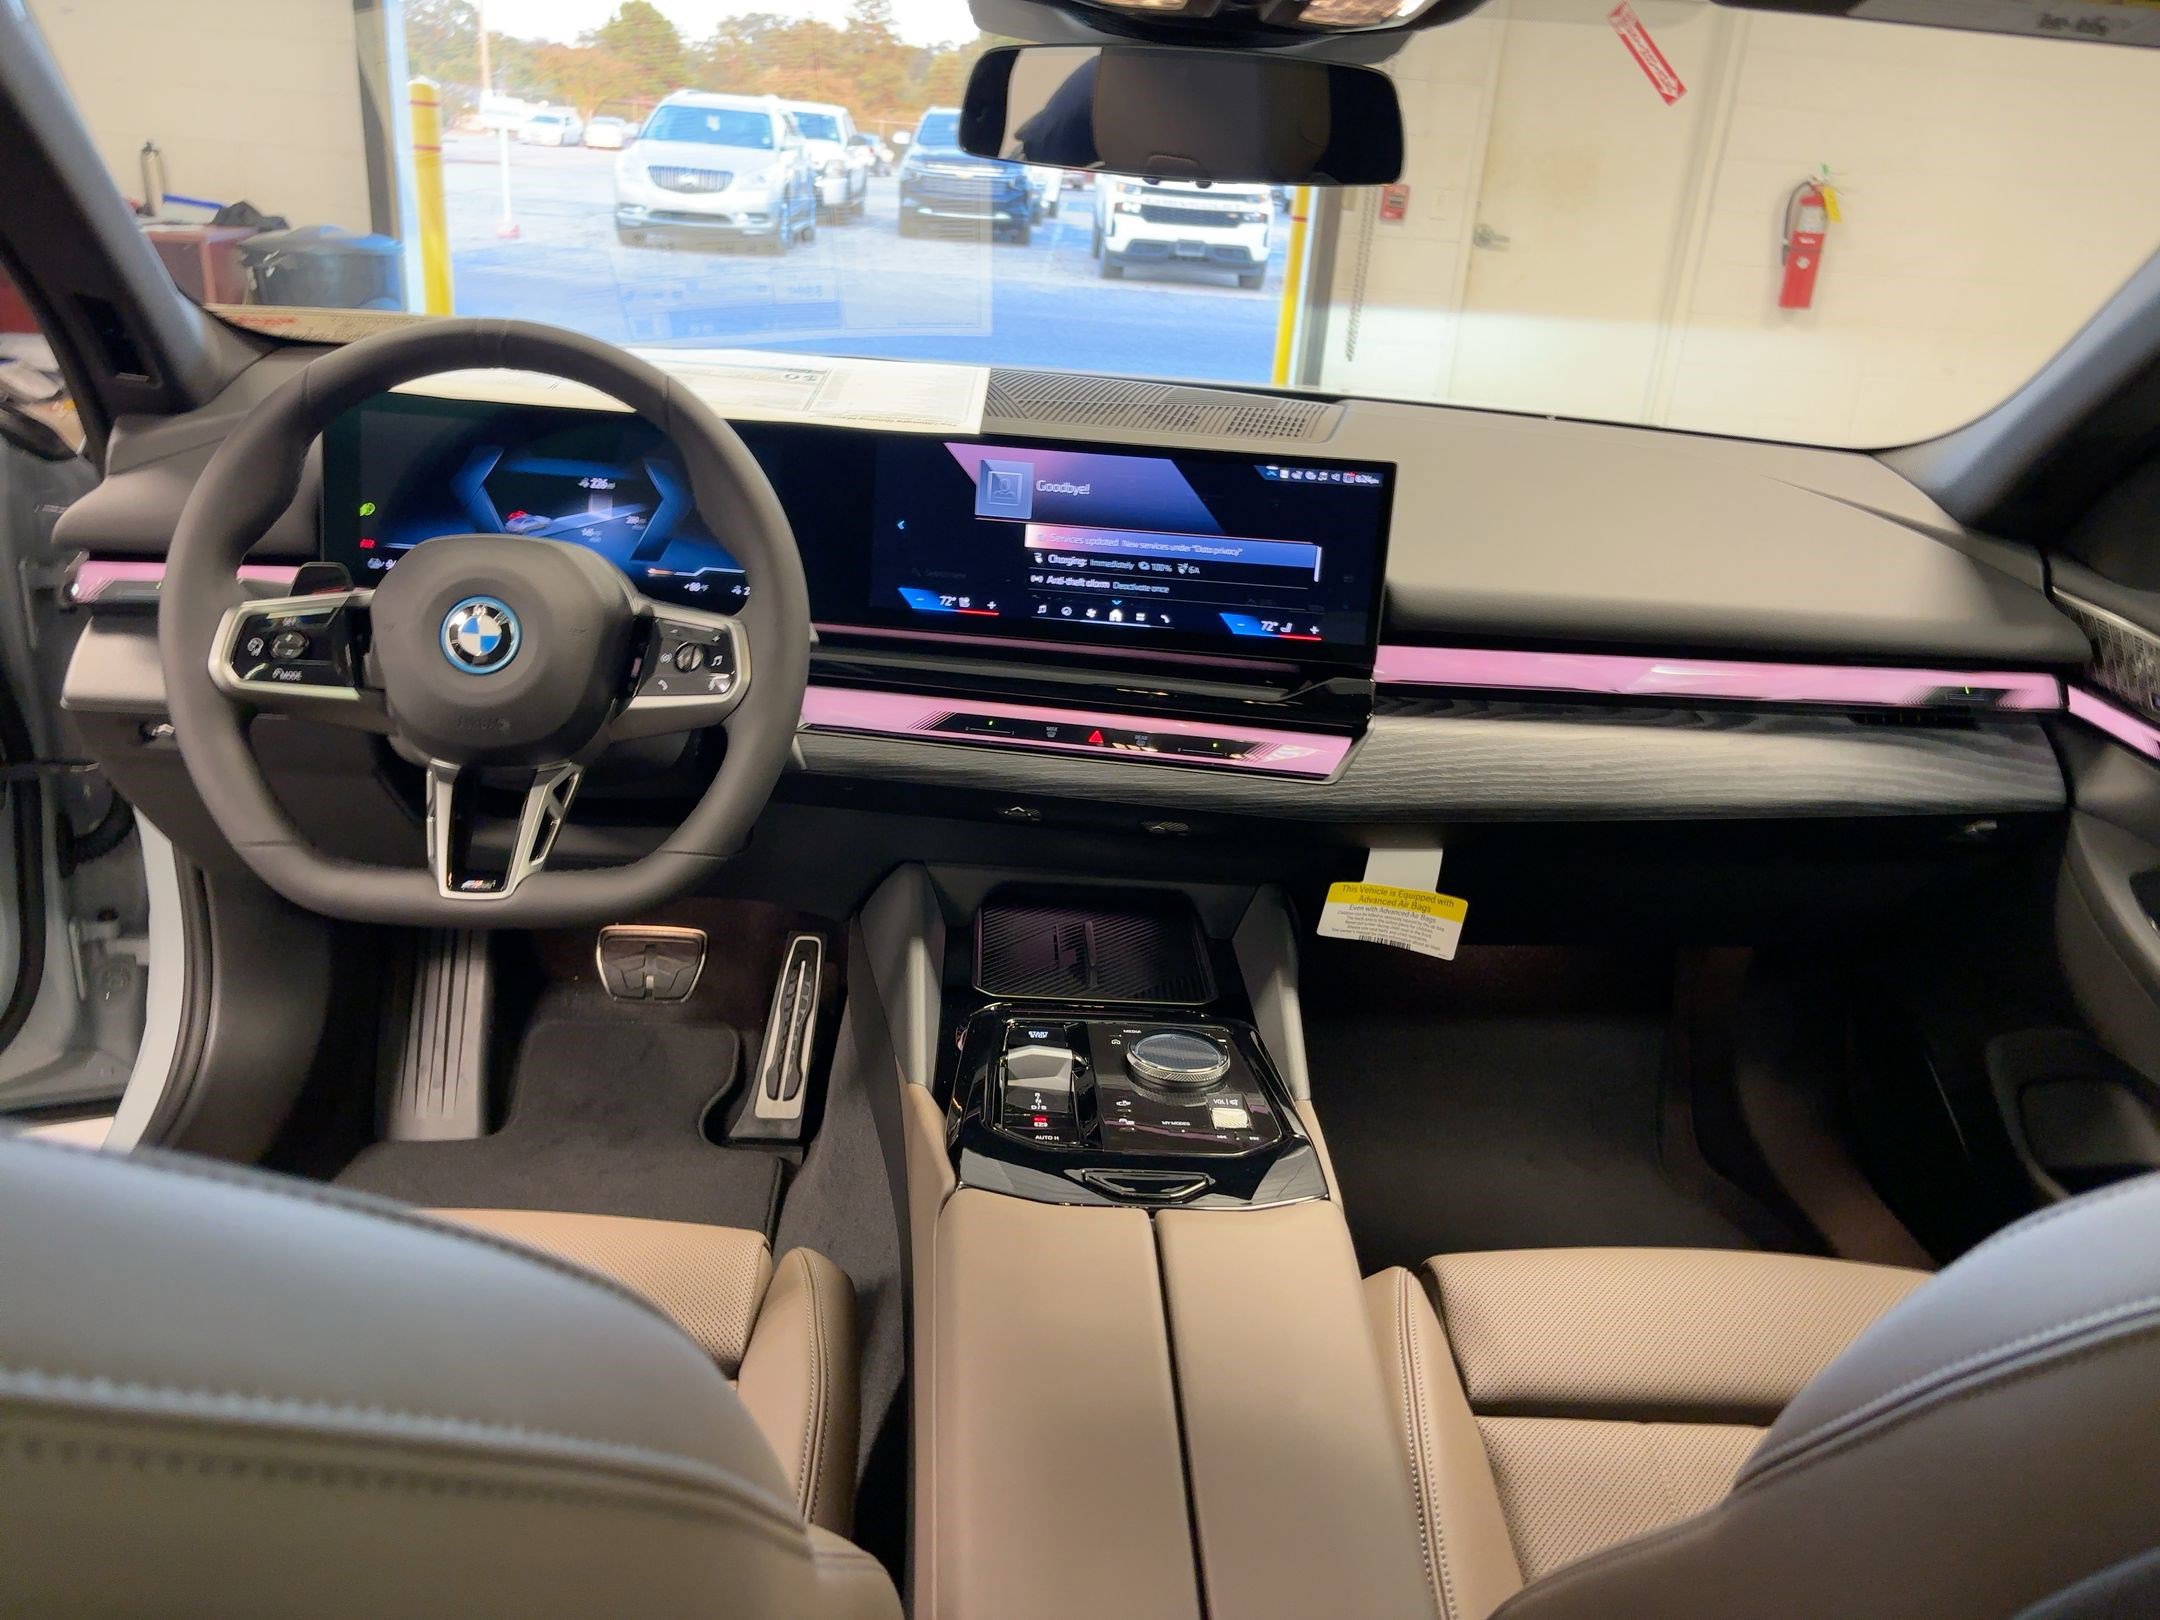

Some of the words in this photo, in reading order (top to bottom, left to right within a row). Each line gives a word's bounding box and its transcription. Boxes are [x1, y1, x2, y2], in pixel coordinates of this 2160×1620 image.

[1036, 480, 1090, 496] Goodbye!
[1342, 885, 1358, 893] This
[1360, 885, 1388, 896] Vehicle
[1398, 890, 1436, 904] Equipped
[1437, 897, 1455, 908] with
[1358, 895, 1397, 906] Advanced
[1398, 900, 1409, 908] Air
[1411, 901, 1431, 913] Bags
